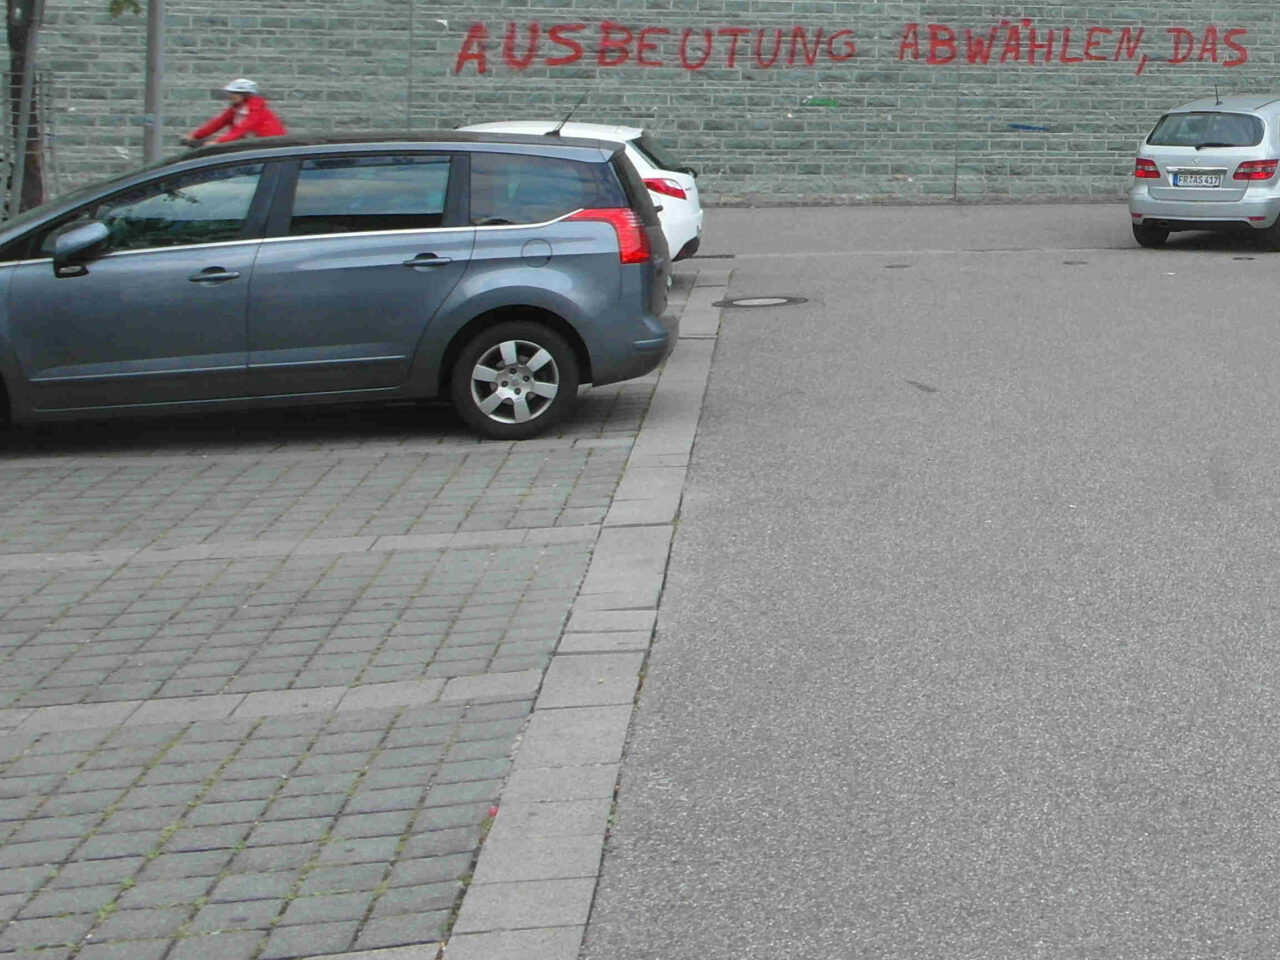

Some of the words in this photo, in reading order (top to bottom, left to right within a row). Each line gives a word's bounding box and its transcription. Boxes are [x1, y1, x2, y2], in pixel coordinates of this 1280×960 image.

[455, 20, 856, 74] AUSBEUTUNG
[899, 19, 1147, 75] ABWÄHLEN,
[1166, 26, 1248, 68] DAS
